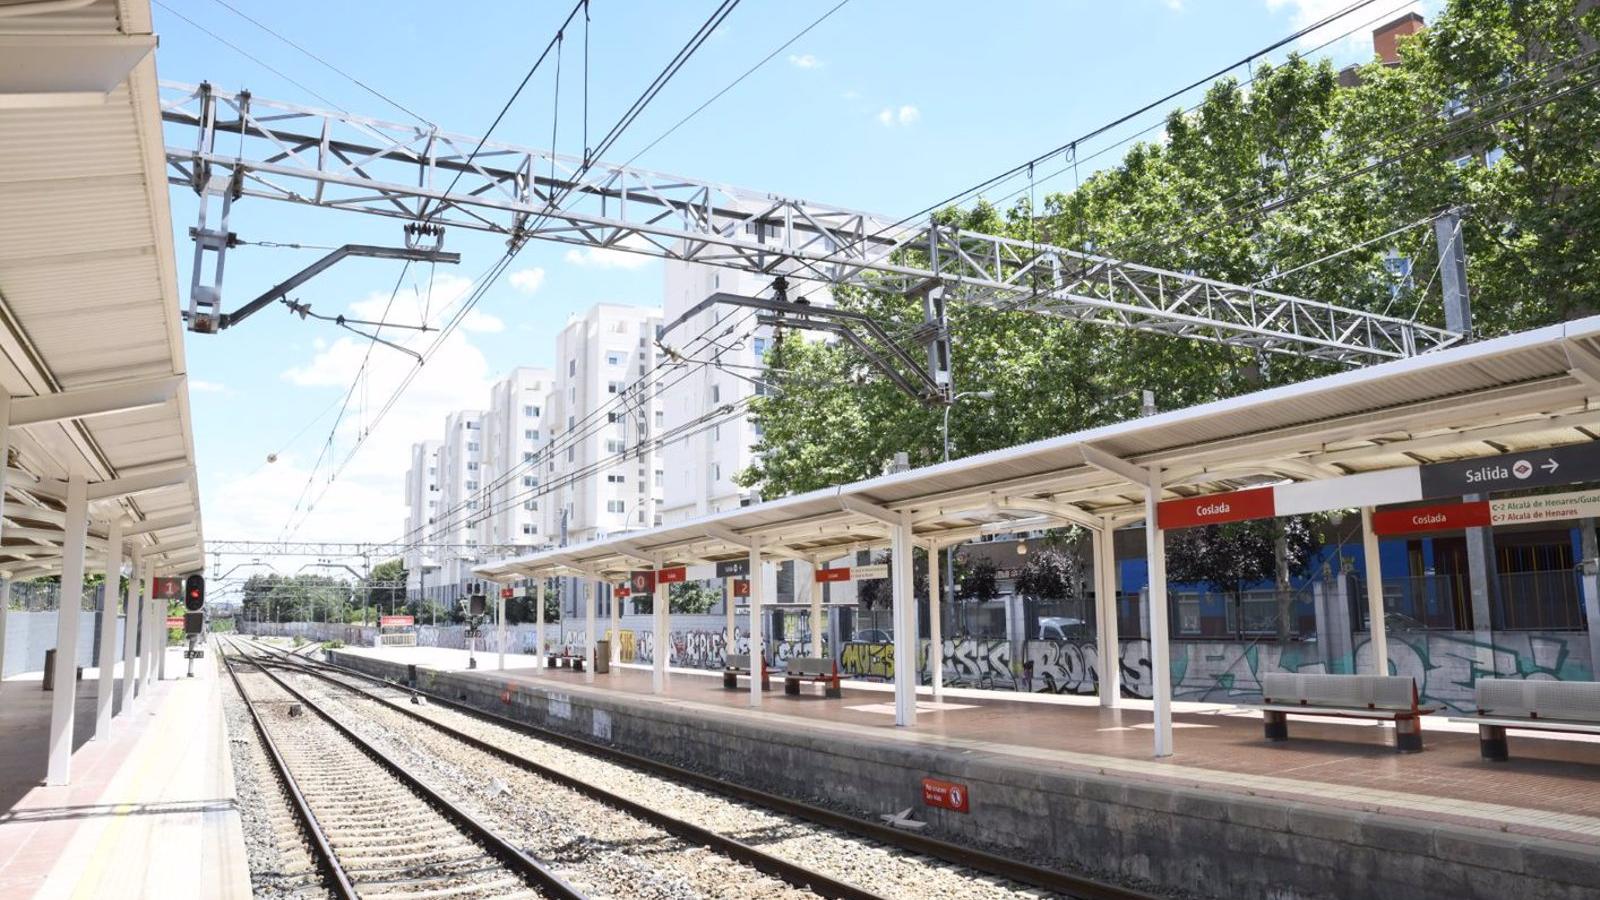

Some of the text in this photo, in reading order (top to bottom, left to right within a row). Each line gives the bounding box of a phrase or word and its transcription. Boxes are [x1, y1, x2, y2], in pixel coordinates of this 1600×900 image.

[1465, 466, 1509, 483] Salida
[1196, 502, 1230, 516] Coslada
[1507, 501, 1531, 511] Alcalá
[1533, 500, 1543, 508] de
[1412, 513, 1447, 525] Coslada
[1492, 514, 1505, 522] C-7
[1533, 510, 1543, 518] de
[1545, 509, 1578, 519] Henares
